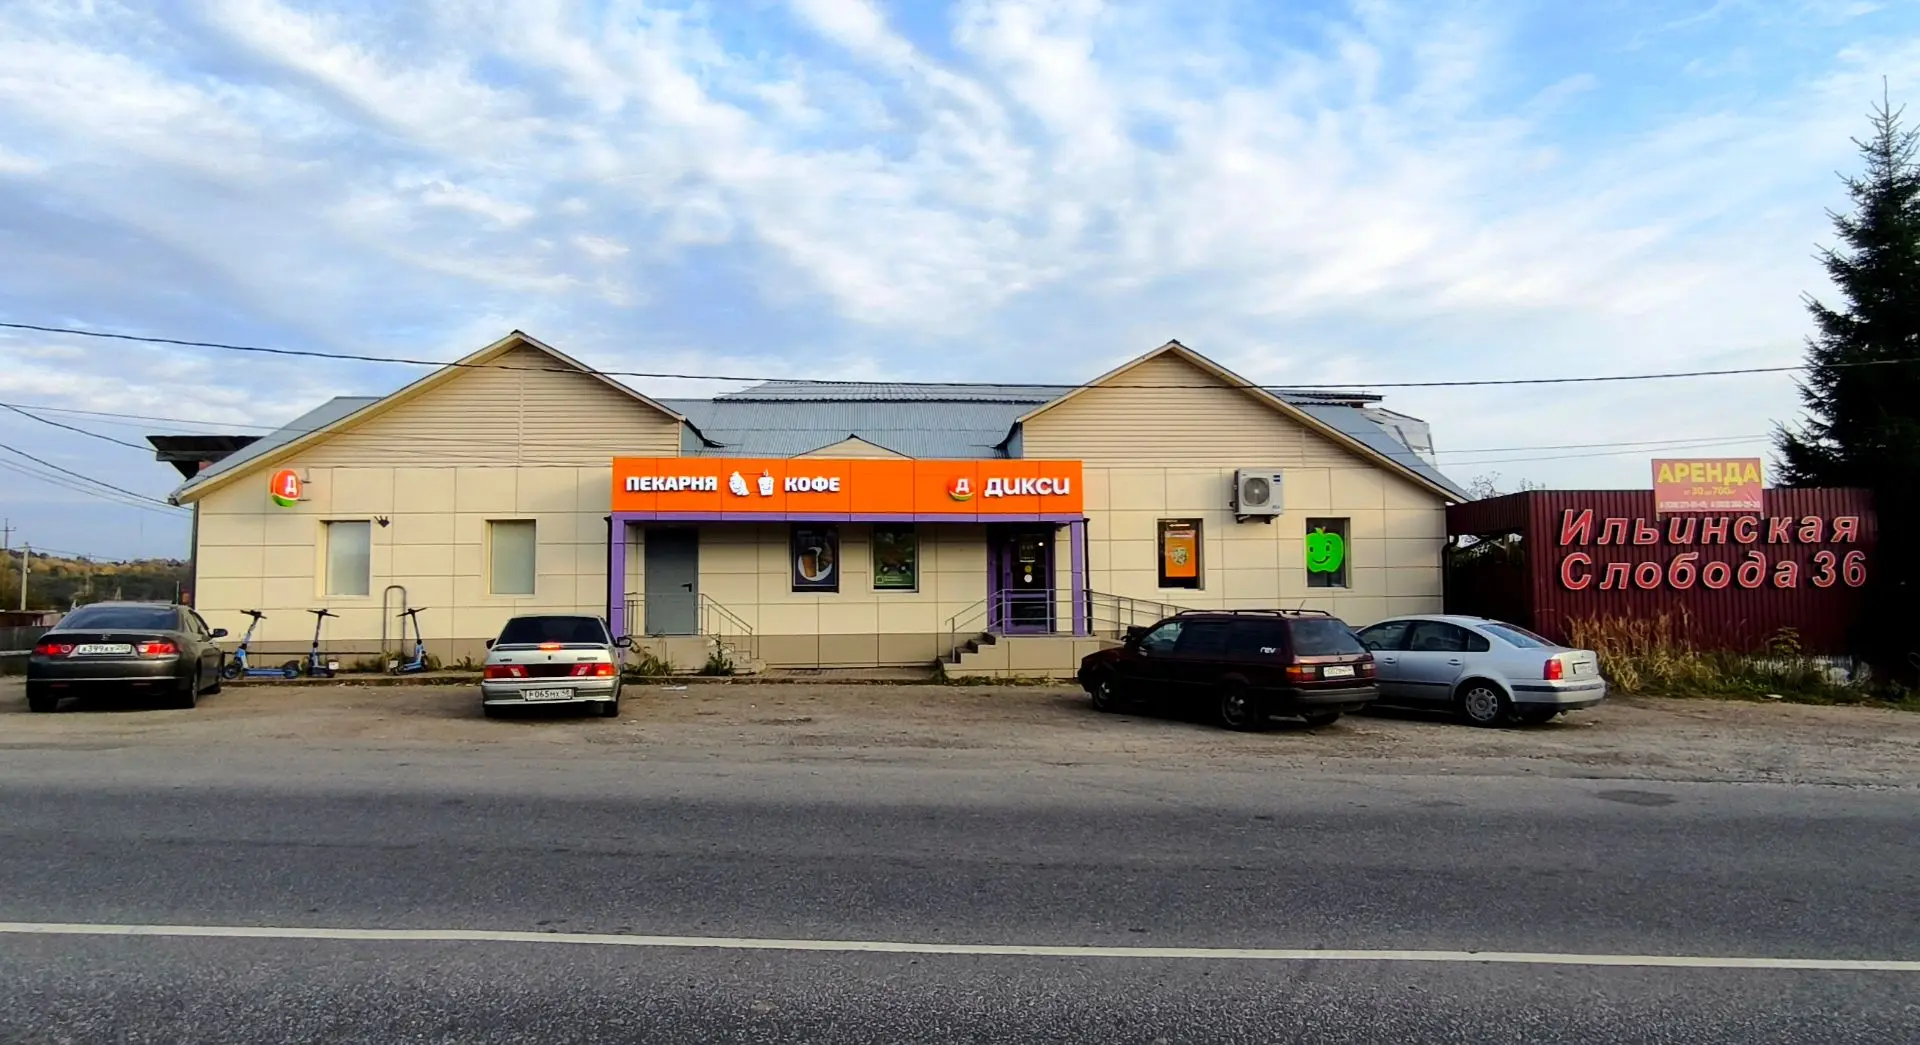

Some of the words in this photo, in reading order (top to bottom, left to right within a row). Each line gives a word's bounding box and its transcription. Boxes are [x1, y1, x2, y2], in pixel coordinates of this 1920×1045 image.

[625, 476, 719, 492] ПЕКАРНЯ
[784, 476, 841, 492] КОФЕ
[955, 478, 970, 493] Д
[1657, 461, 1760, 486] АРЕНДА
[1560, 508, 1859, 546] Ильинская
[1561, 551, 1799, 590] Слобода
[1812, 550, 1867, 588] 36
